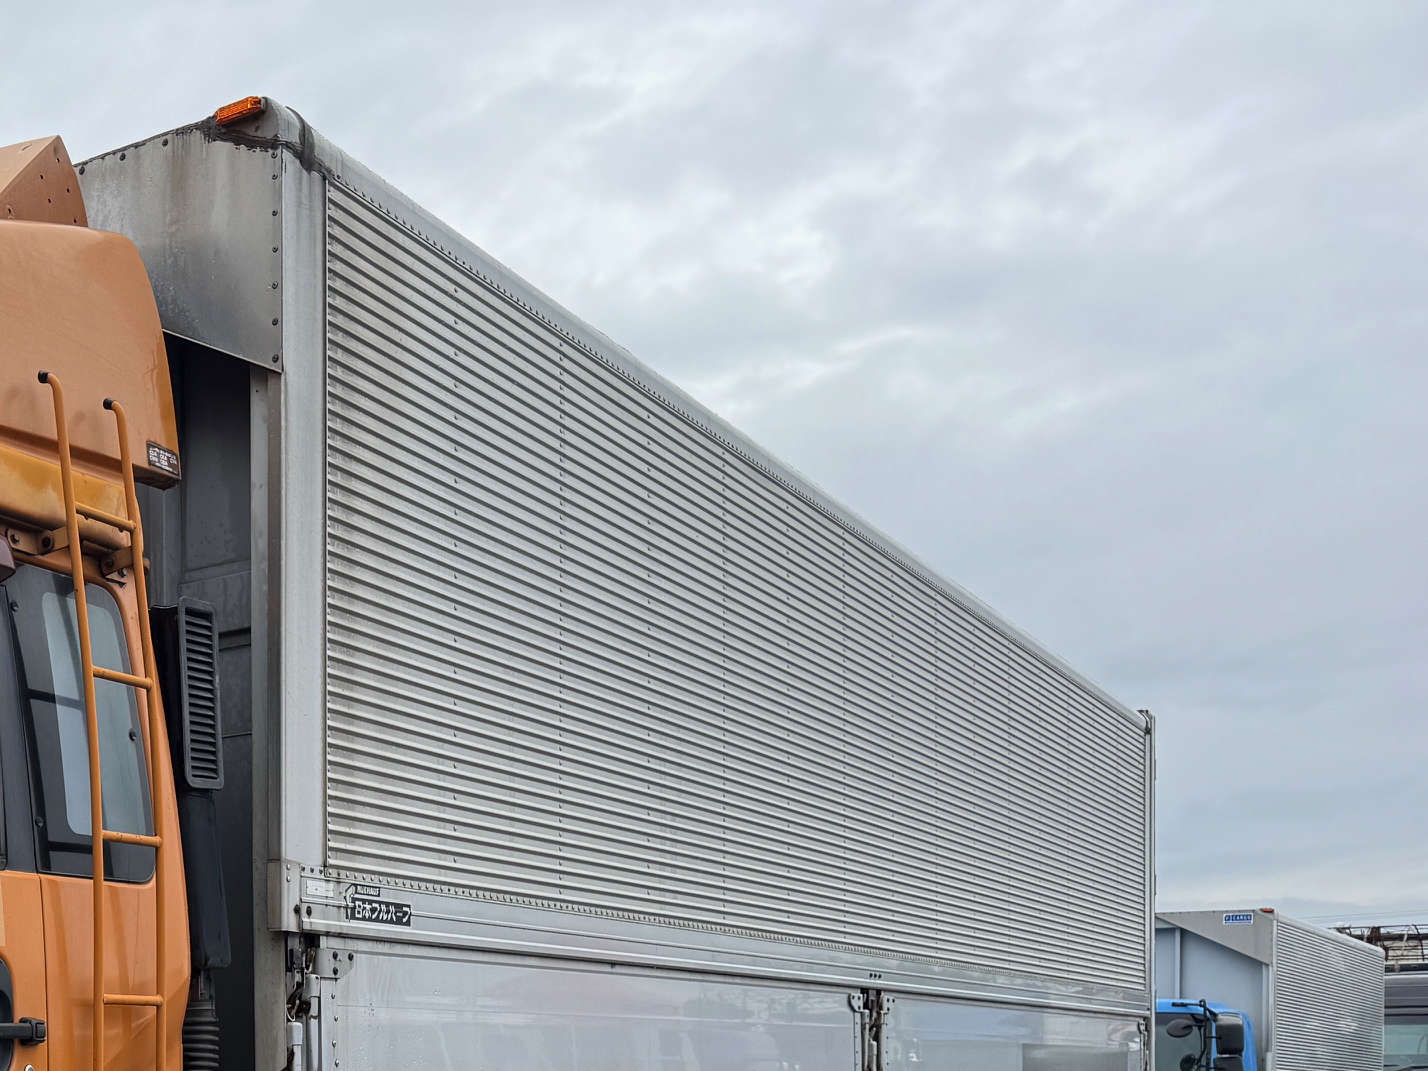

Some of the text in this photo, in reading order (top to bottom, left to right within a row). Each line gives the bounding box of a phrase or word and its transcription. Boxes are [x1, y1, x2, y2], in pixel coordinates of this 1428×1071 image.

[355, 901, 411, 923] 日本フルハーフ
